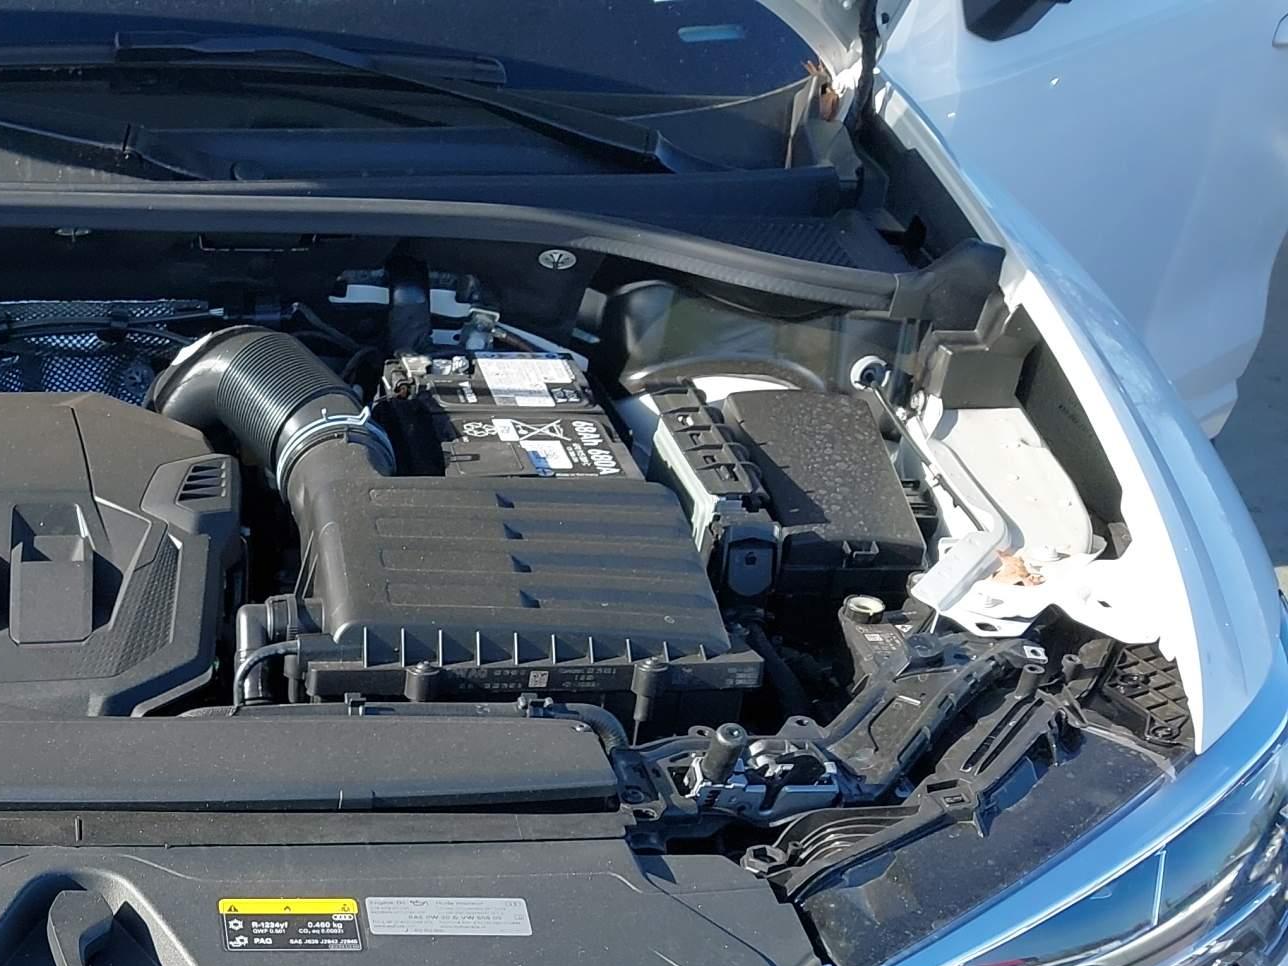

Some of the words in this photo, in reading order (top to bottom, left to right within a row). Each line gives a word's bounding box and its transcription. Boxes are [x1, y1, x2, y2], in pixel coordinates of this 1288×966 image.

[571, 420, 604, 446] 68Ah
[587, 448, 621, 476] 680A
[251, 921, 288, 929] R-1234yf
[332, 921, 344, 930] kg
[253, 937, 273, 945] PAG
